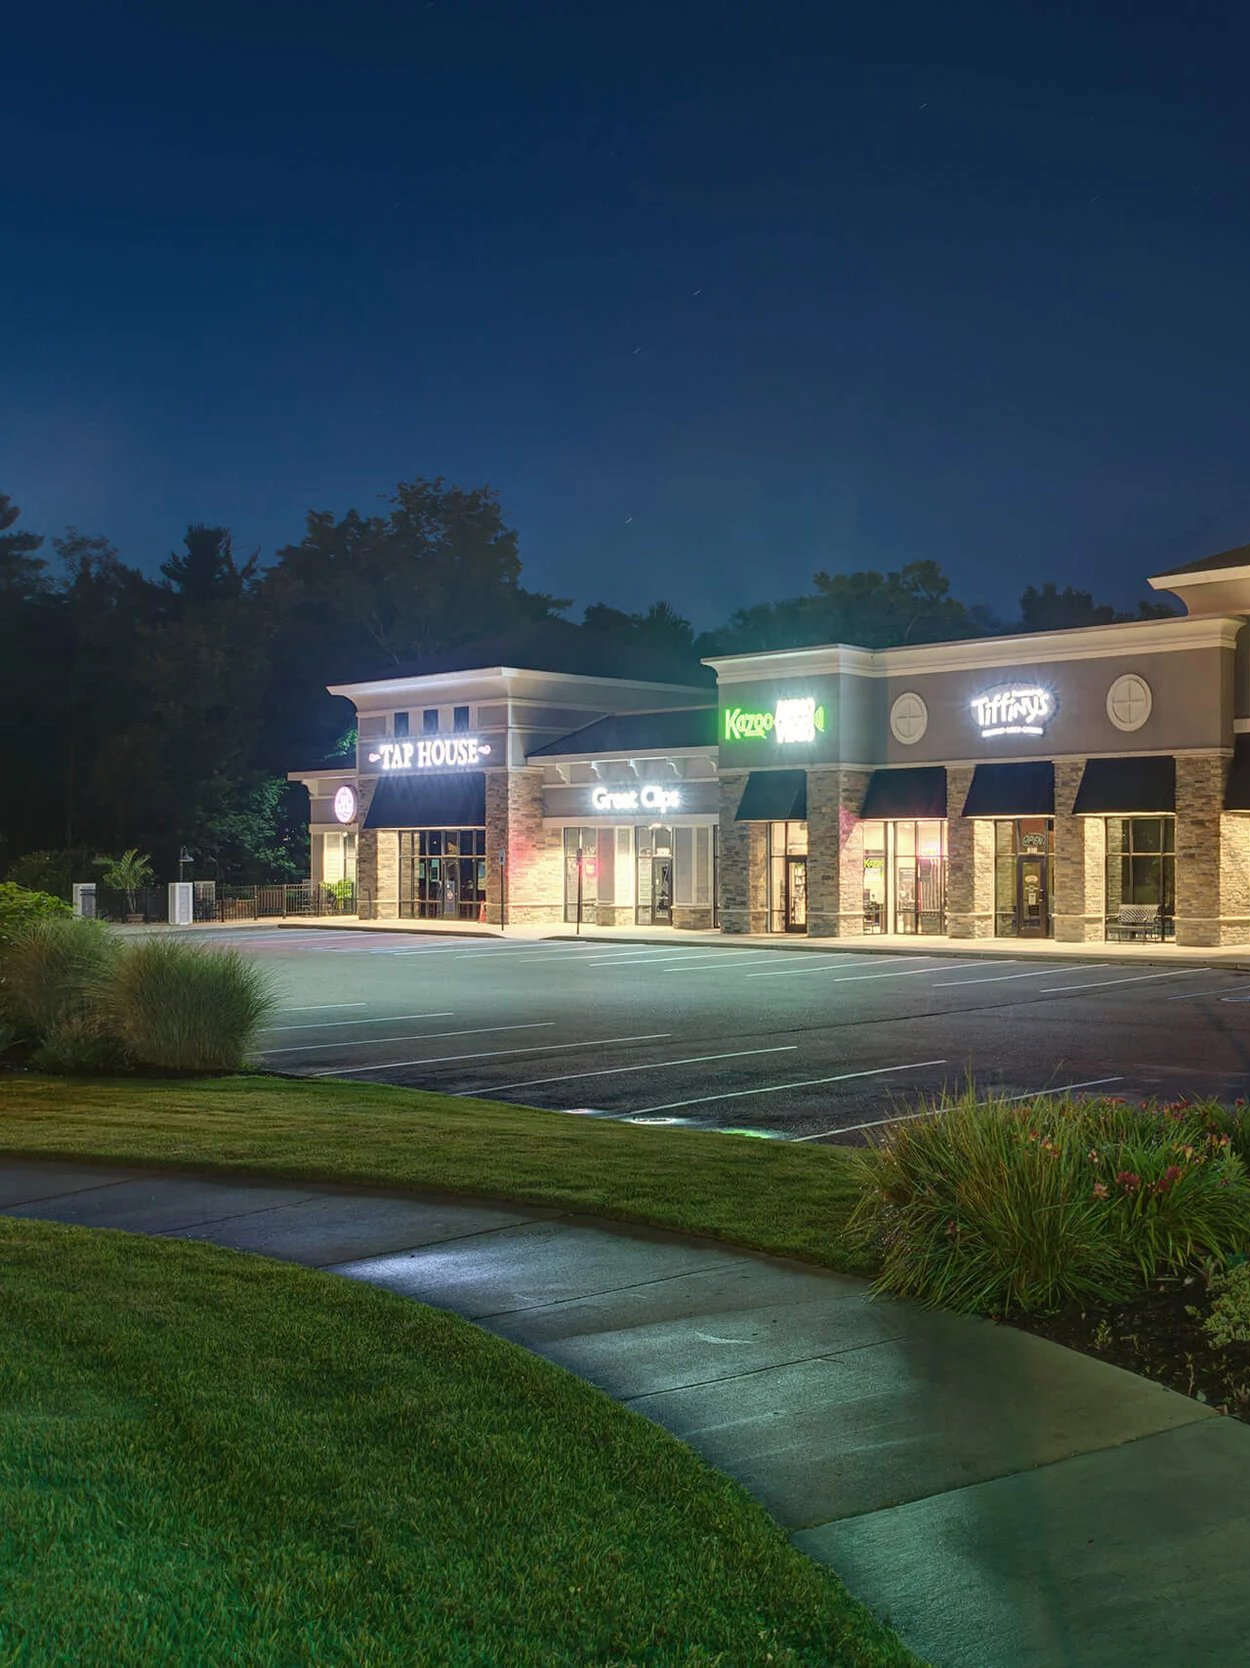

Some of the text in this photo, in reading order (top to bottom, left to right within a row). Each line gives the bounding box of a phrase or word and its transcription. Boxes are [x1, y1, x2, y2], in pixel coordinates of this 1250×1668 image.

[724, 708, 774, 740] Kazoo
[379, 738, 479, 770] TAP HOUSE
